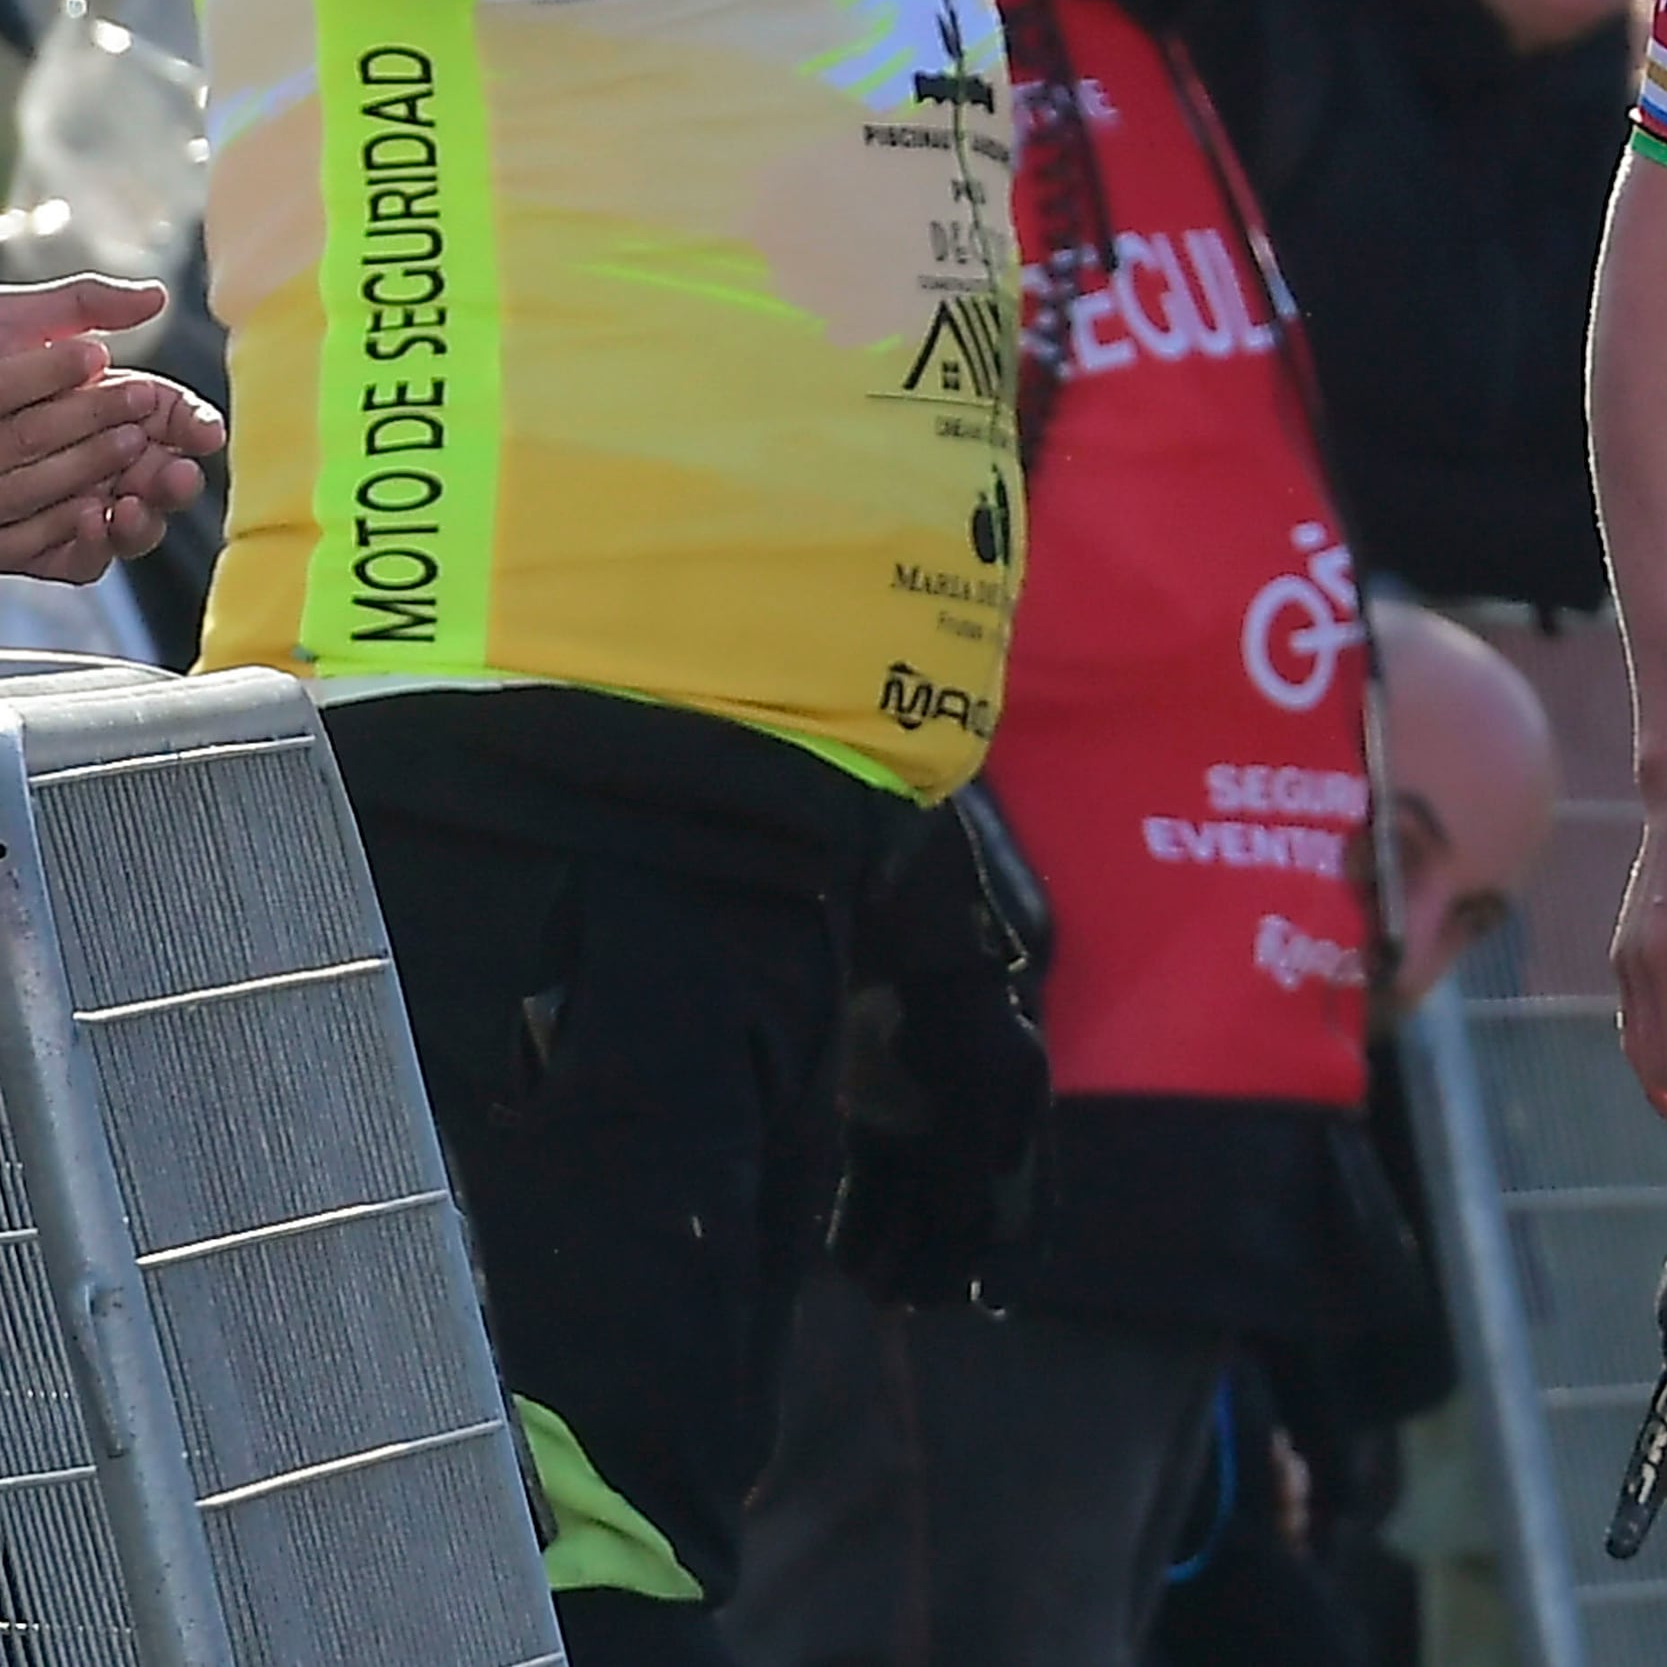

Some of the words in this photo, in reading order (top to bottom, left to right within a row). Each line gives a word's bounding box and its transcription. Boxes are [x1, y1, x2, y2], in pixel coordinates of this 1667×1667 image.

[359, 44, 444, 360] SEGURIDAD
[362, 379, 444, 458] DE
[352, 471, 439, 644] MOTO
